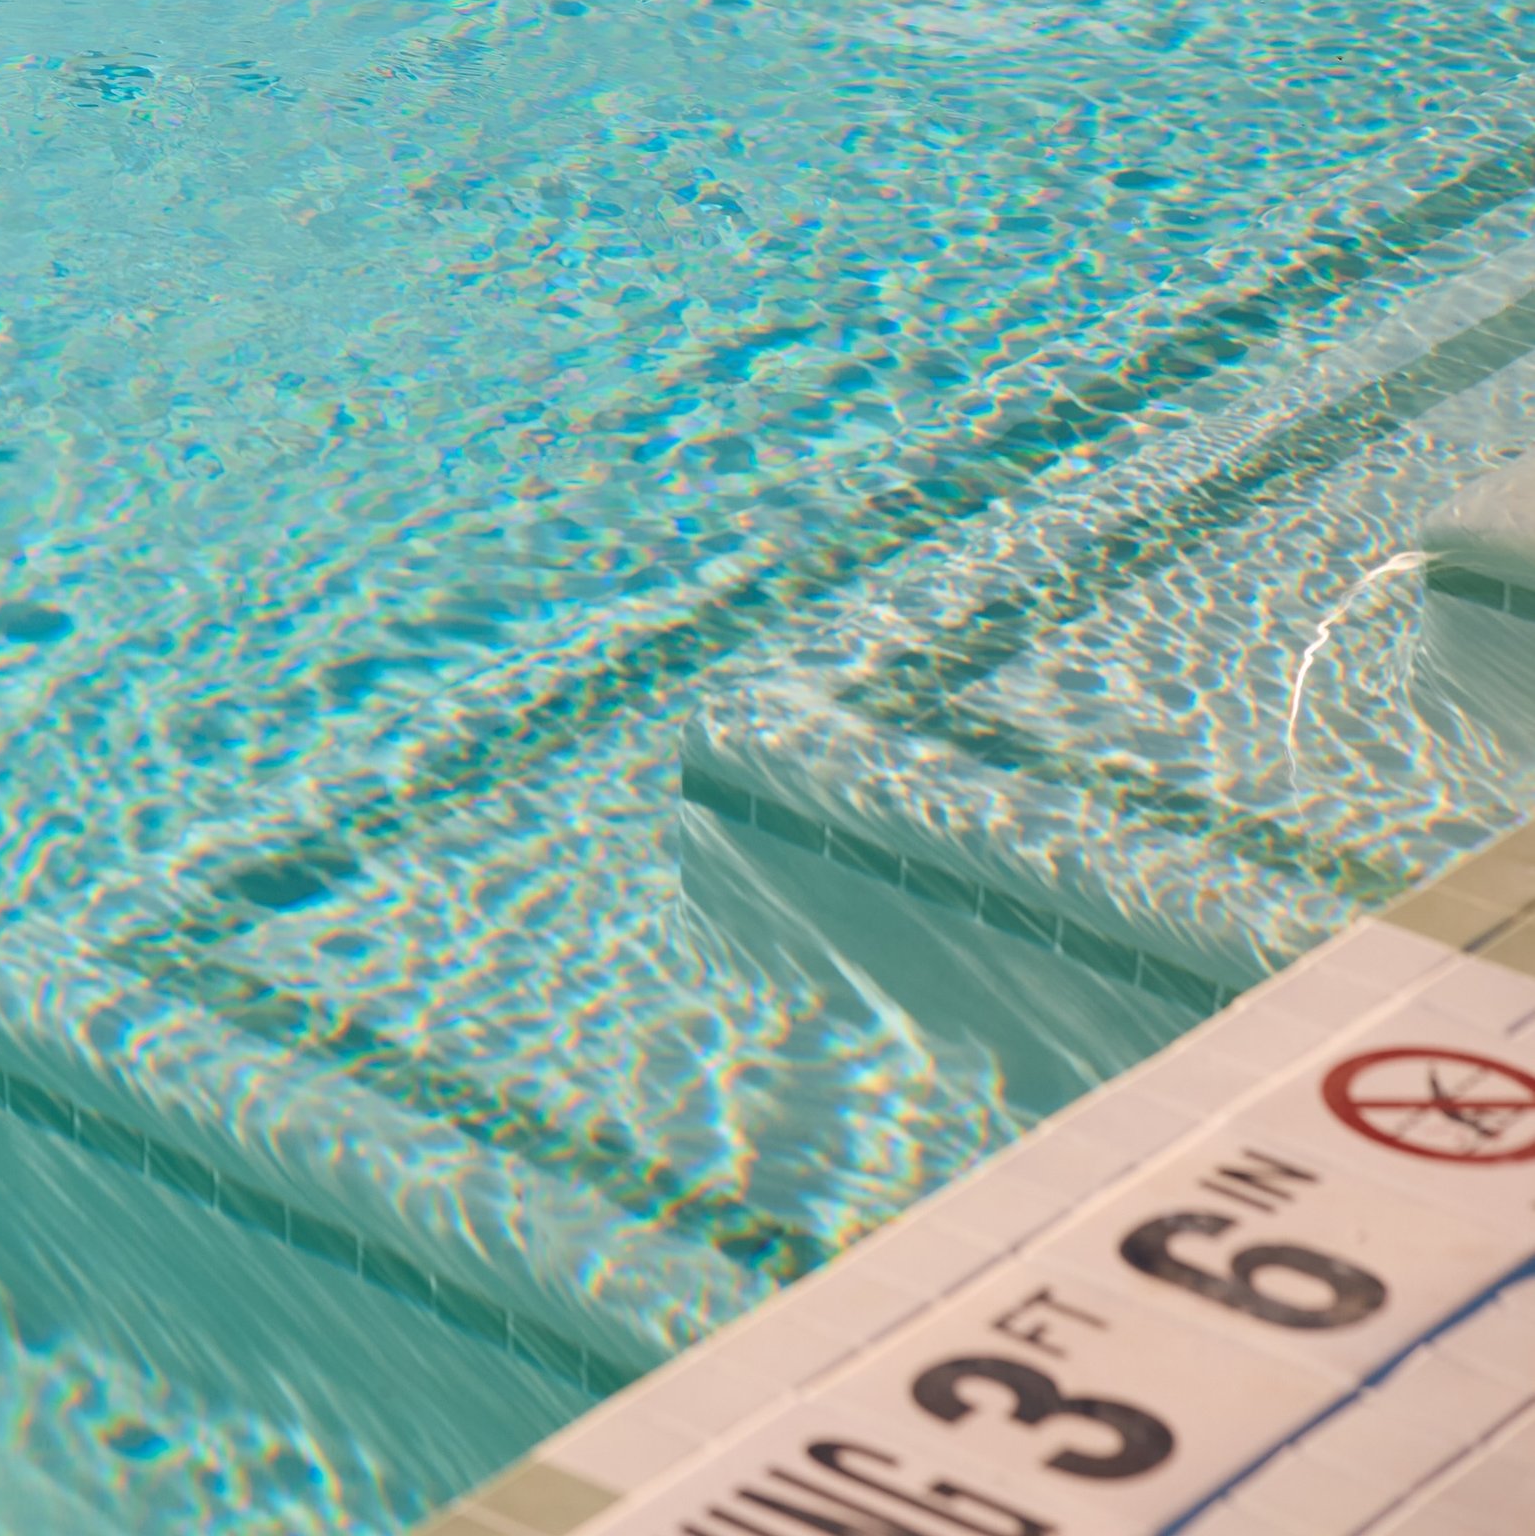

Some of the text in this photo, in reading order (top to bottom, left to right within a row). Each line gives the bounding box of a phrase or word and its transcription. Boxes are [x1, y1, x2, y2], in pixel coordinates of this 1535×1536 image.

[911, 1146, 1389, 1482] 3 FT 6 IN
